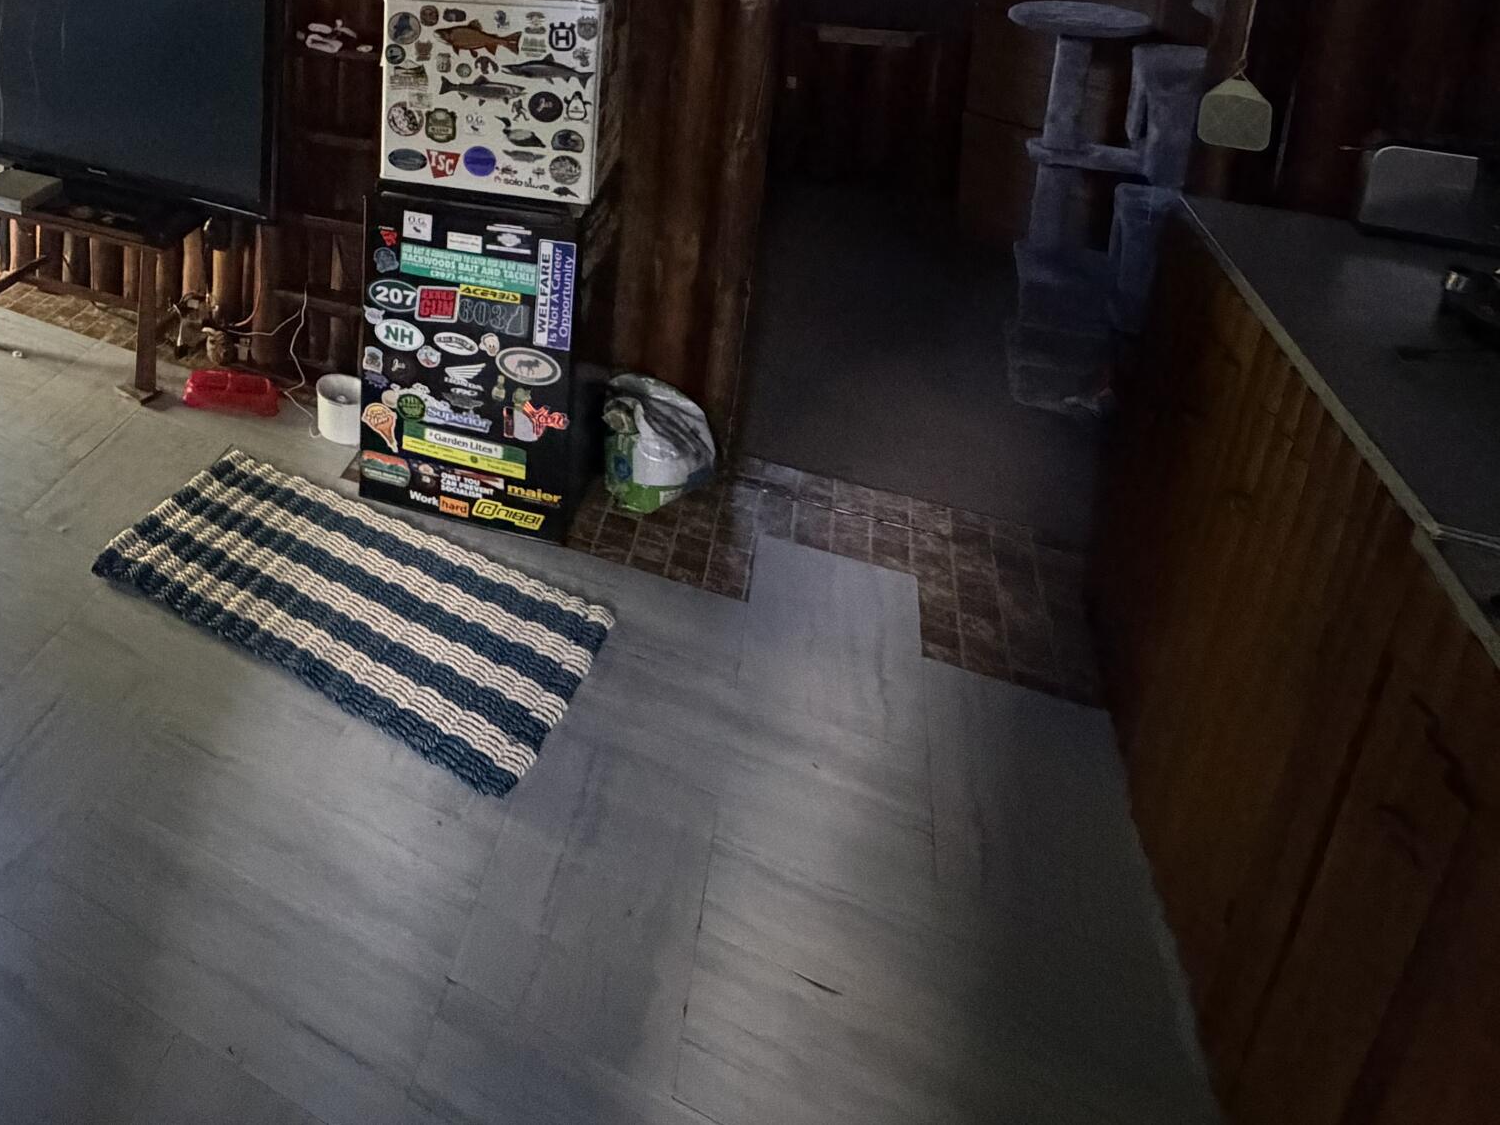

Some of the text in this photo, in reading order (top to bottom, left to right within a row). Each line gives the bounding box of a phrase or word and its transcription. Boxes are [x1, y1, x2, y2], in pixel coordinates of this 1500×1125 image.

[429, 151, 454, 175] TSC
[503, 177, 522, 187] solo
[403, 251, 456, 270] BACKWOODS
[458, 262, 479, 274] BAIT
[481, 265, 501, 277] AND
[375, 285, 417, 306] 207
[538, 253, 551, 334] WELFARE
[548, 248, 563, 342] Is Not A Career
[558, 255, 575, 338] Opportunity
[458, 298, 505, 328] 603
[384, 324, 414, 345] NH
[427, 407, 490, 430] Superior
[434, 433, 469, 447] Garden
[470, 441, 493, 454] Lites
[441, 472, 481, 486] ONLY YOU
[441, 478, 494, 496] CAN PREVENT
[409, 489, 467, 514] Work hard
[441, 485, 483, 499] SOCIALISM
[507, 484, 562, 504] maier
